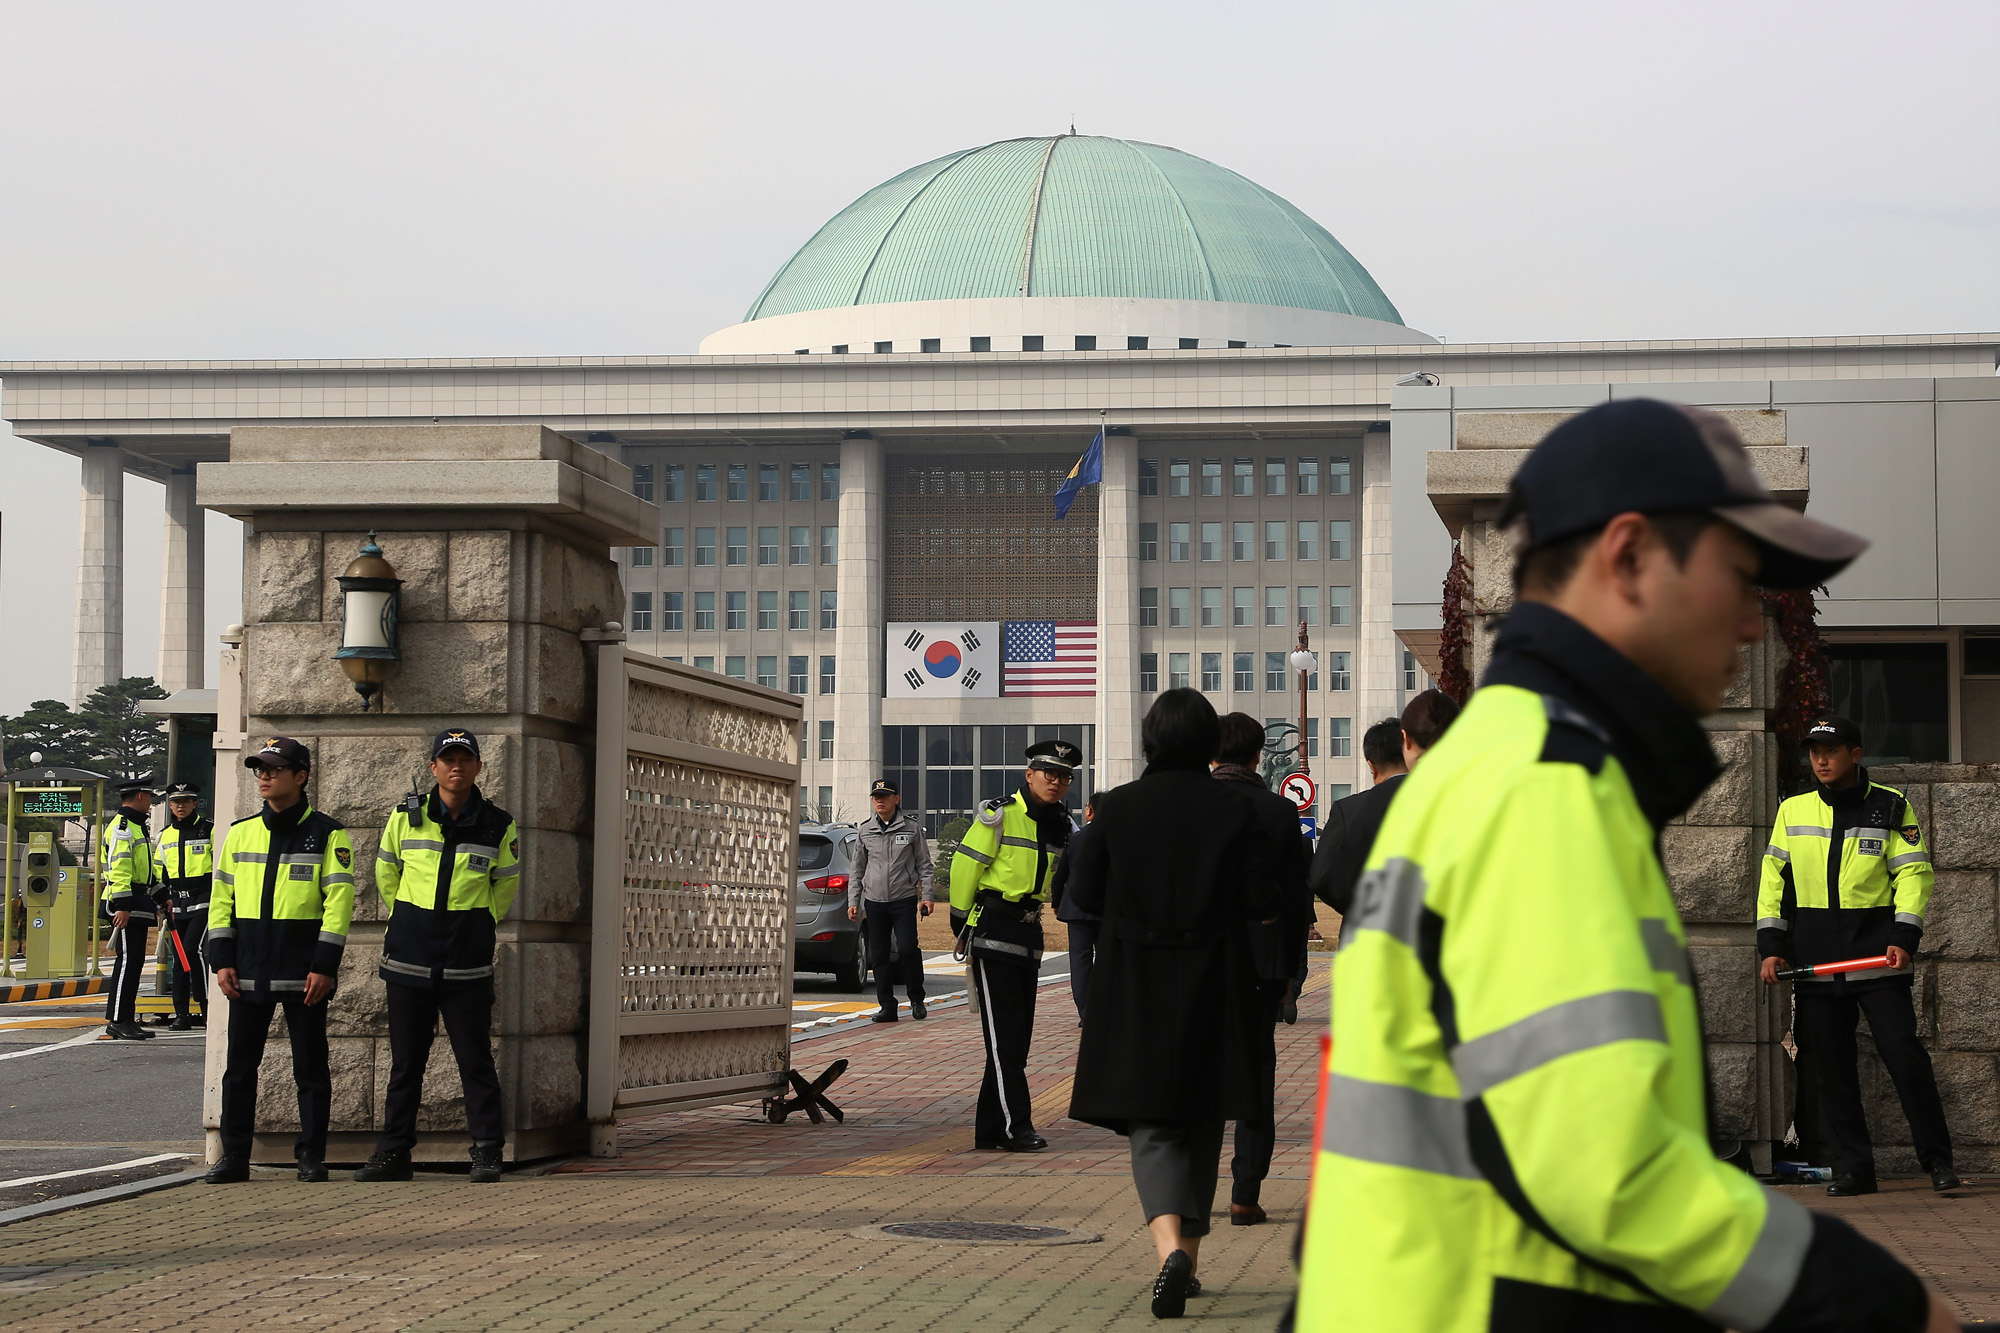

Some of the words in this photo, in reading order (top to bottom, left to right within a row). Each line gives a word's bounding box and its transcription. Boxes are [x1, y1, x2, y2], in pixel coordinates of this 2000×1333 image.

[1810, 725, 1836, 734] POLICE
[442, 737, 471, 745] POLICE
[39, 792, 69, 803] 주차는
